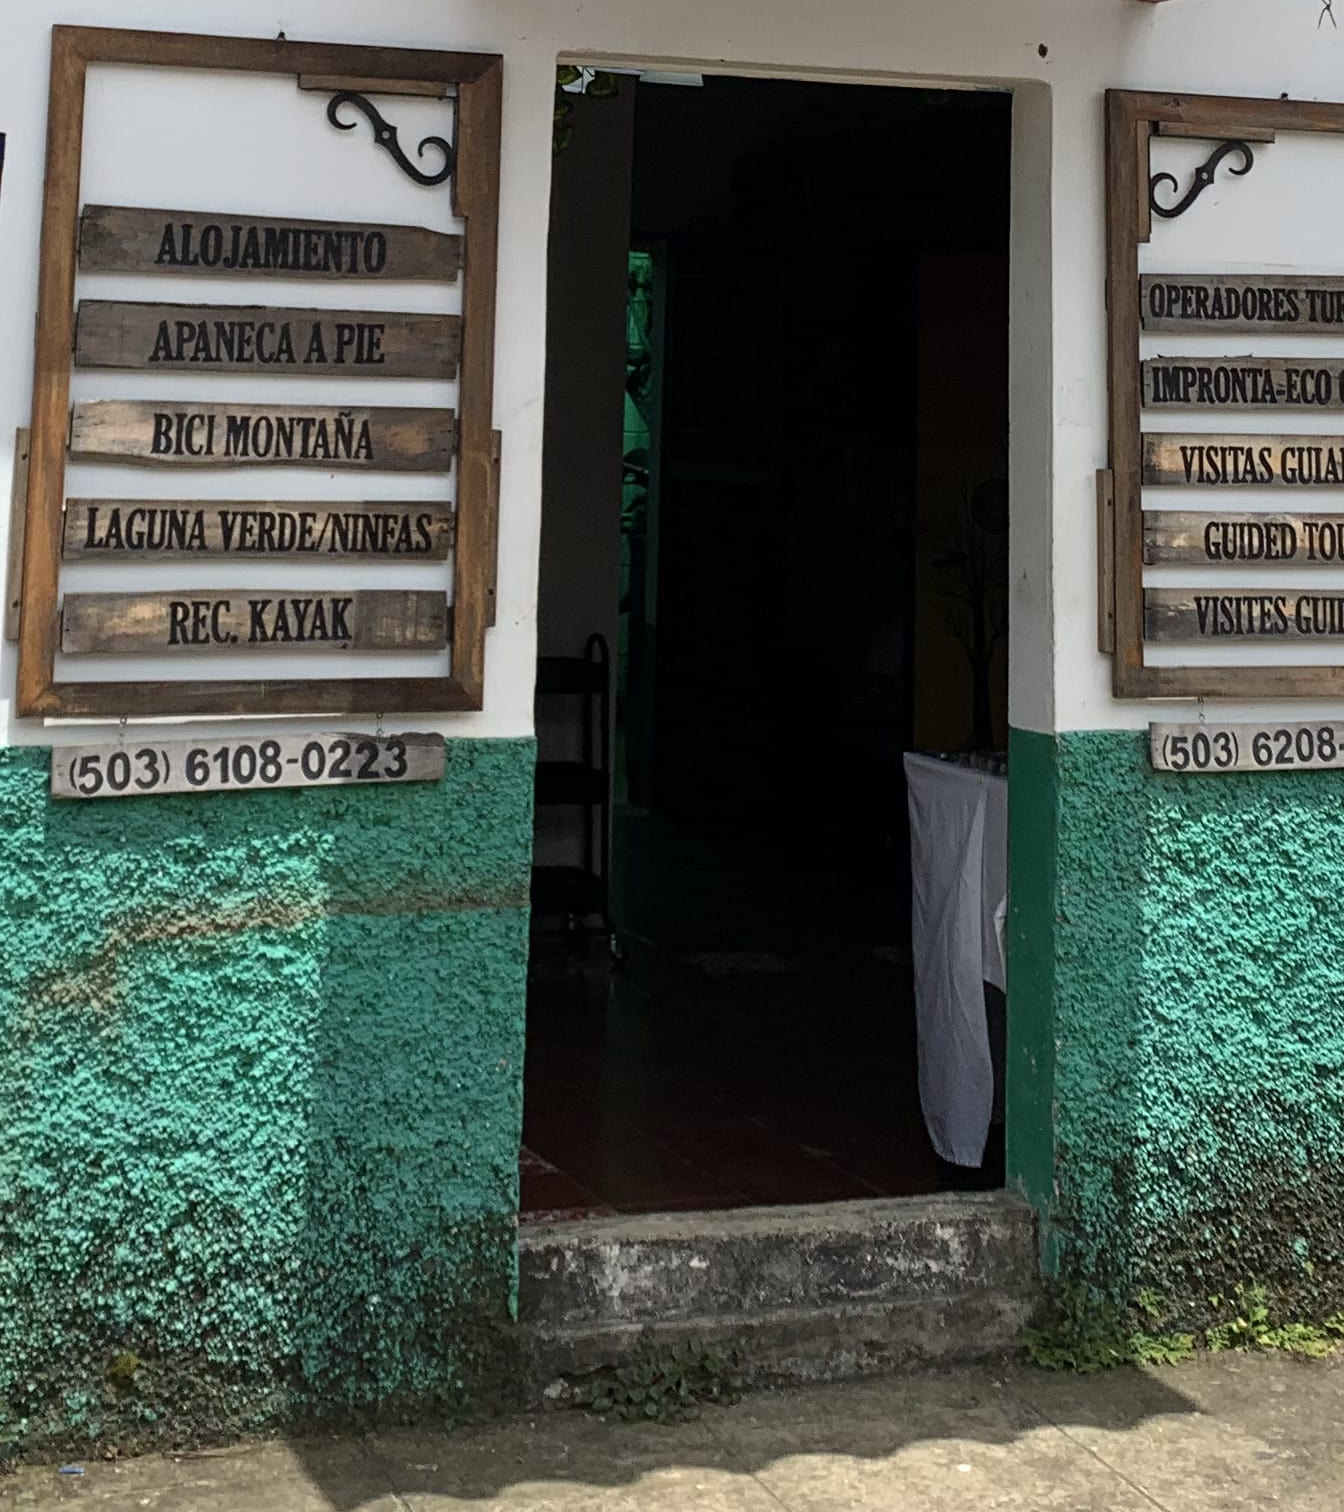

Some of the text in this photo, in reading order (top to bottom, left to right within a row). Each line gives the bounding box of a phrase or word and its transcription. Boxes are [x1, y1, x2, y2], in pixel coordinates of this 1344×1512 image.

[154, 222, 387, 274] ALOJAMIENTO
[1149, 283, 1300, 322] OPERADORES
[148, 319, 386, 365] APANECA A PIE
[150, 412, 374, 460] BICI MONTAÑA
[1180, 446, 1275, 484] VISITAS
[83, 506, 433, 554] LAGUNA VERDE/NINFAS
[1204, 521, 1297, 560] GUIDED
[167, 597, 354, 645] REC. KAYAK
[1193, 596, 1288, 636] VISITES
[68, 738, 408, 796] (503) 6108-0223
[1162, 731, 1239, 771] (503)
